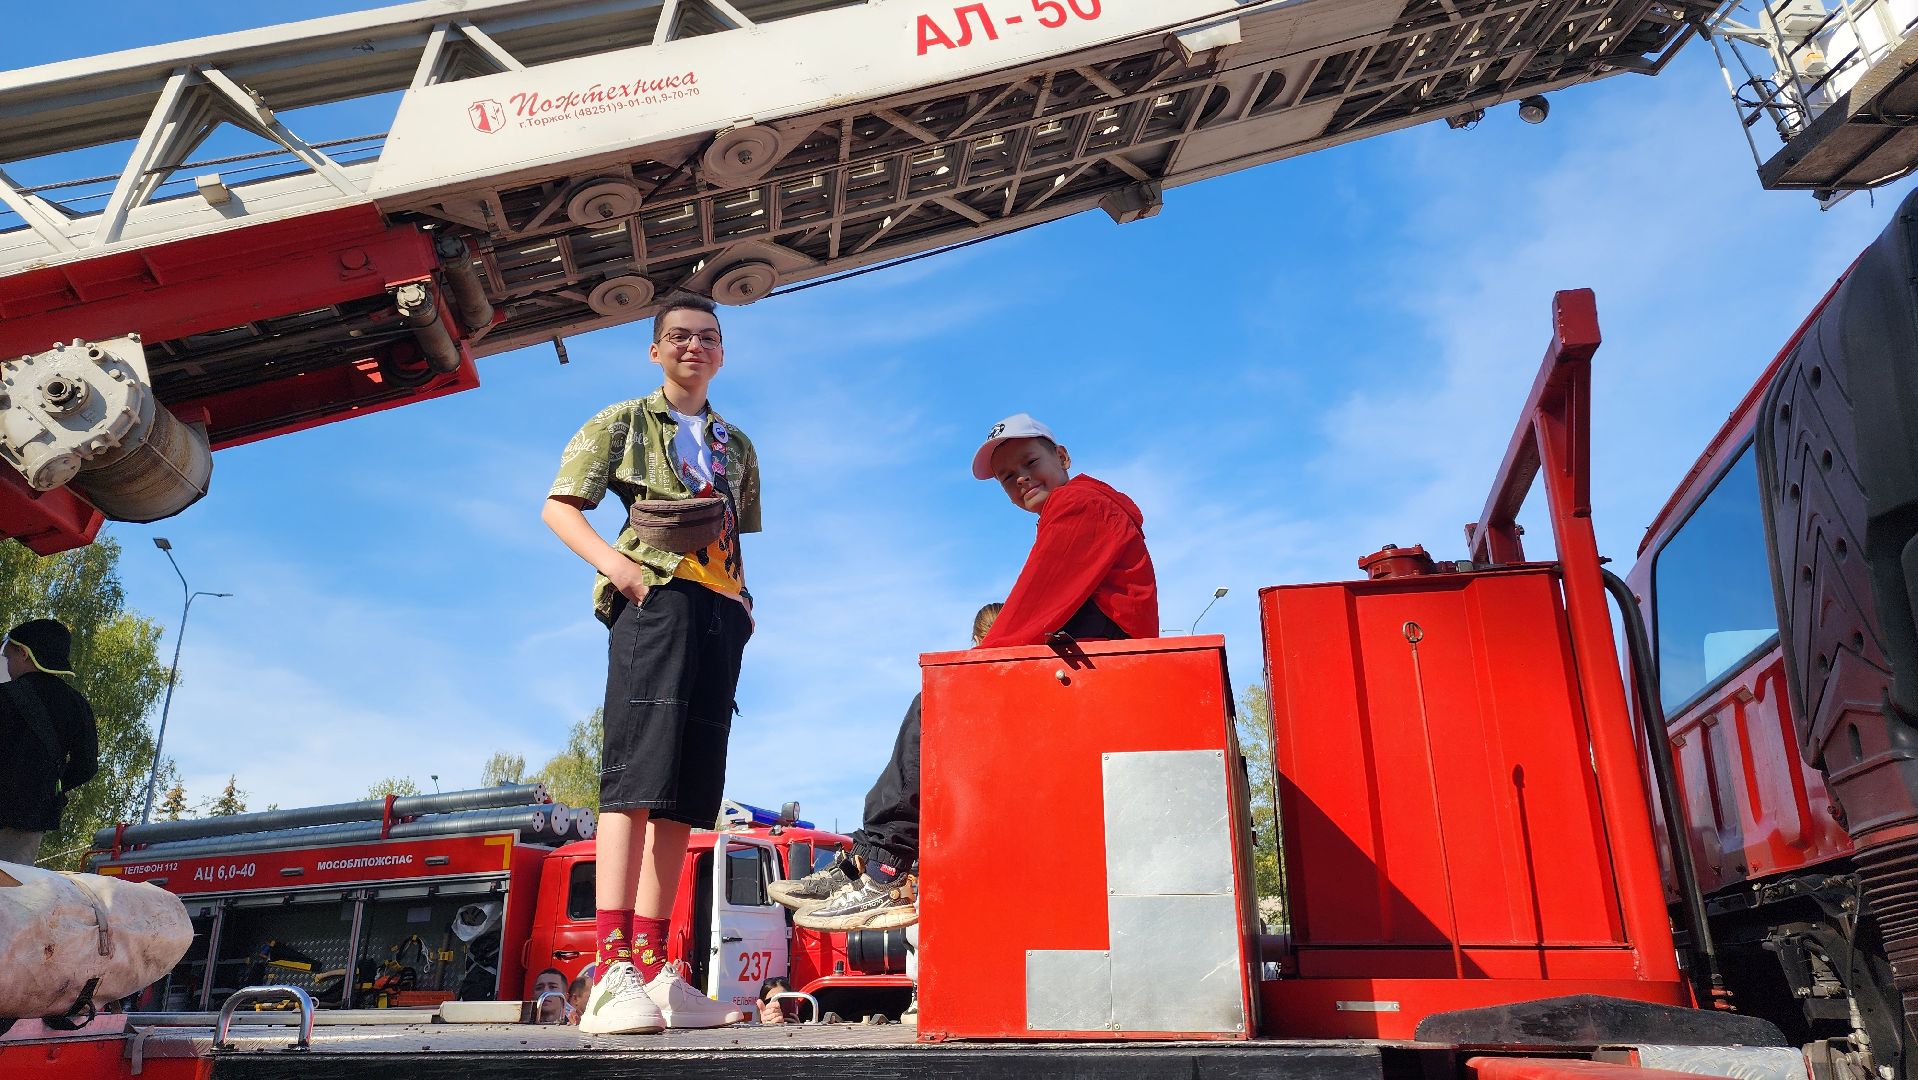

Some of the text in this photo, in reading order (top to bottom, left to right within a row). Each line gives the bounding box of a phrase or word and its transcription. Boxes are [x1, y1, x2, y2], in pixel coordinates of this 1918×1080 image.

[509, 71, 698, 117] Пожтехника
[519, 112, 572, 129] г.Торжок
[124, 862, 178, 875] ТЕЛЕФОН 112
[317, 854, 413, 871] МОСОБЛПОЖСПАС
[194, 862, 256, 882] АЦ 6,0-40
[738, 951, 772, 982] 237
